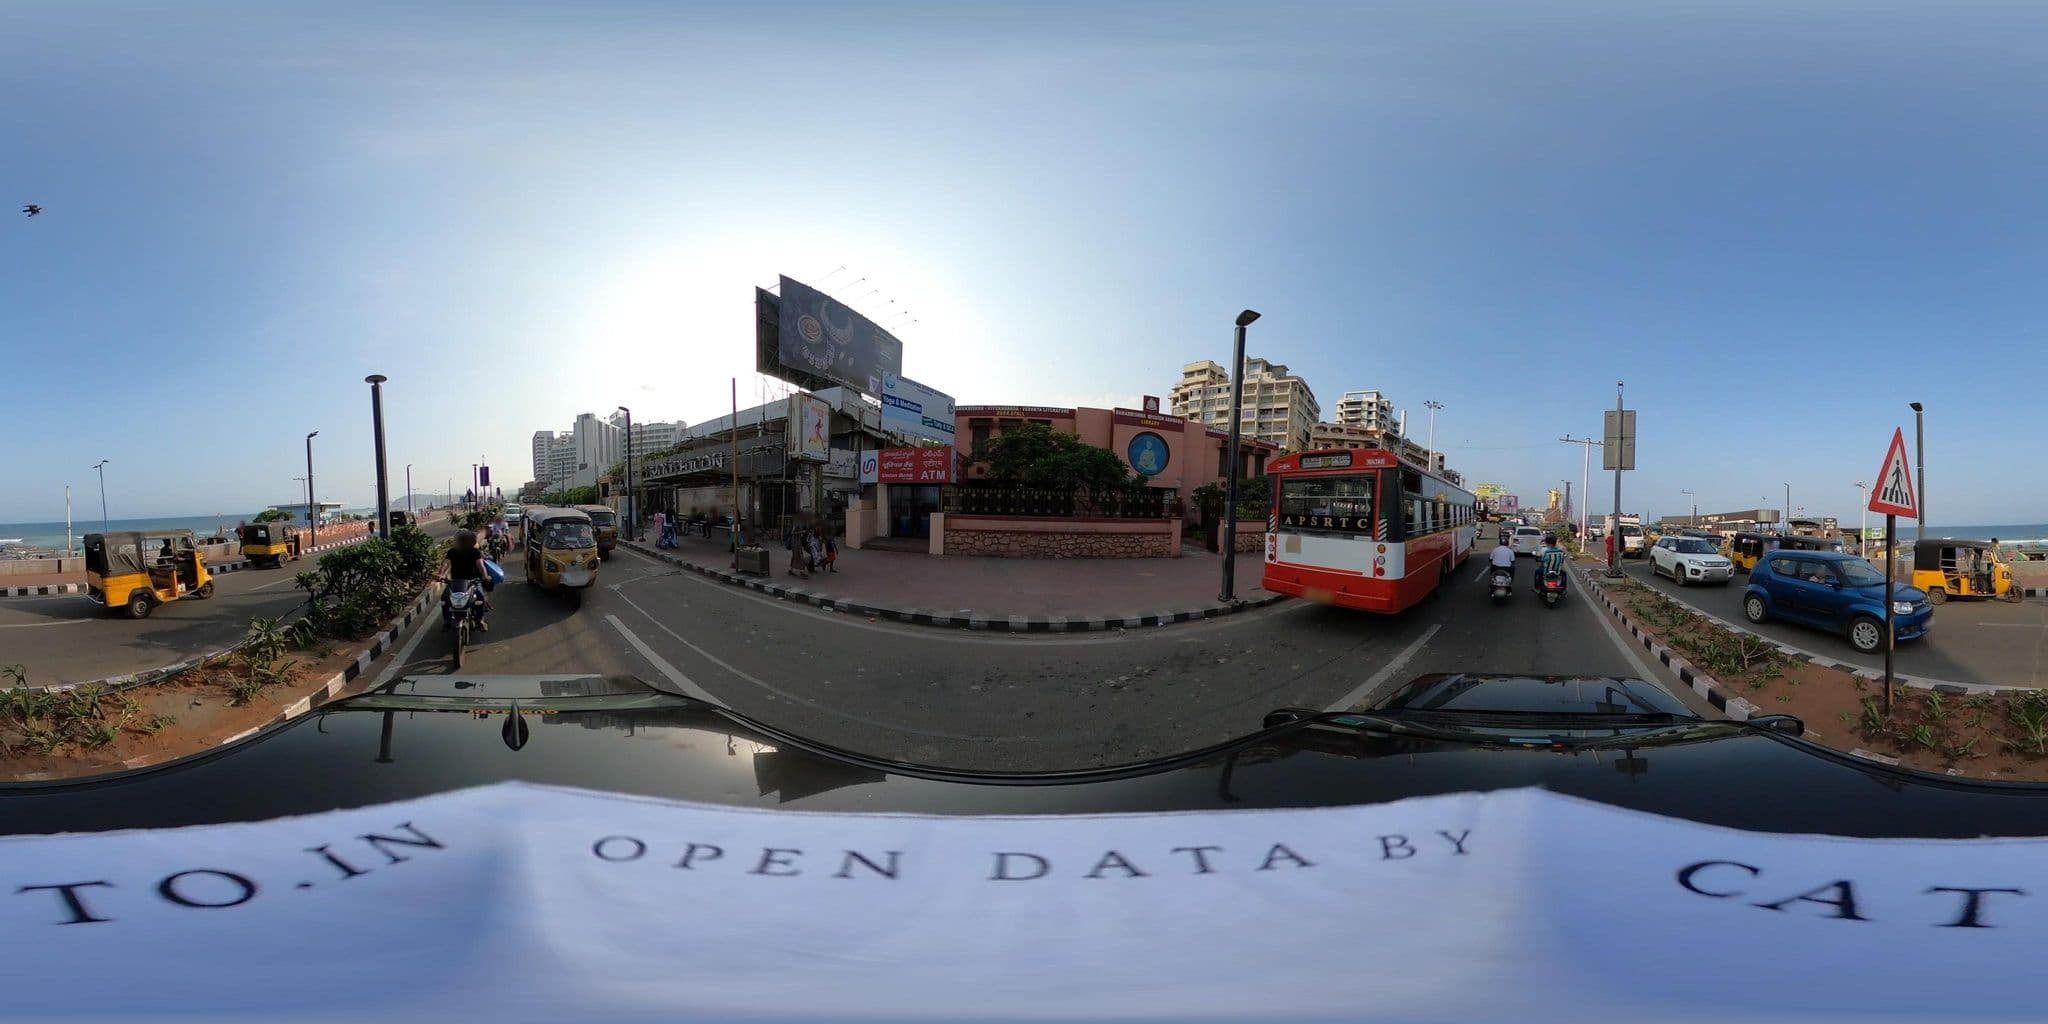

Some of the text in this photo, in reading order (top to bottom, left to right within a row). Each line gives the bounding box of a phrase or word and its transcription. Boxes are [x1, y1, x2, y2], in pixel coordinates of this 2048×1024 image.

[1140, 419, 1160, 427] LIBRARY
[920, 470, 945, 480] ATM
[591, 828, 1472, 881] OPEN DATA BY
[1674, 859, 2028, 929] CAT
